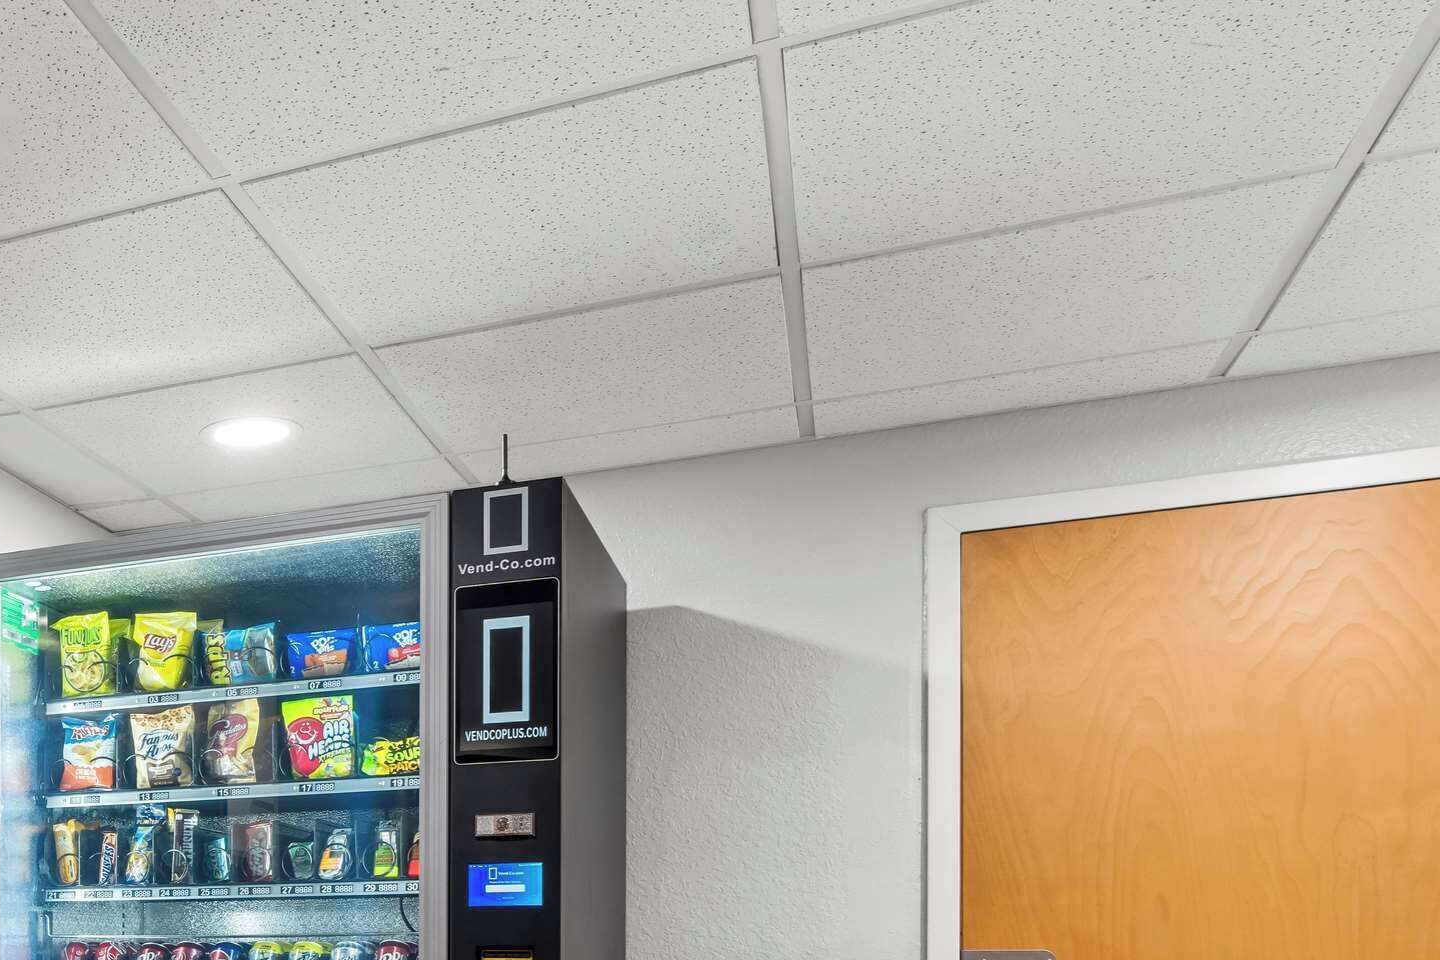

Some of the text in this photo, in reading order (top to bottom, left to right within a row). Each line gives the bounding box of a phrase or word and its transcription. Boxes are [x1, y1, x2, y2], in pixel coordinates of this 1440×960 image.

[458, 556, 556, 575] Vend-Co.com
[396, 673, 407, 682] 09
[309, 681, 320, 690] 07
[227, 688, 237, 696] 05
[149, 695, 159, 704] 03
[322, 719, 351, 740] AIR
[465, 726, 548, 742] VENDCOPLUS.COM
[389, 759, 420, 773] PATC
[392, 779, 403, 787] 19
[217, 788, 229, 796] 15
[302, 784, 312, 792] 17
[140, 792, 150, 801] 13
[200, 888, 210, 896] 25
[239, 887, 249, 895] 26
[281, 886, 292, 894] 27
[321, 885, 332, 893] 28
[365, 884, 376, 892] 29
